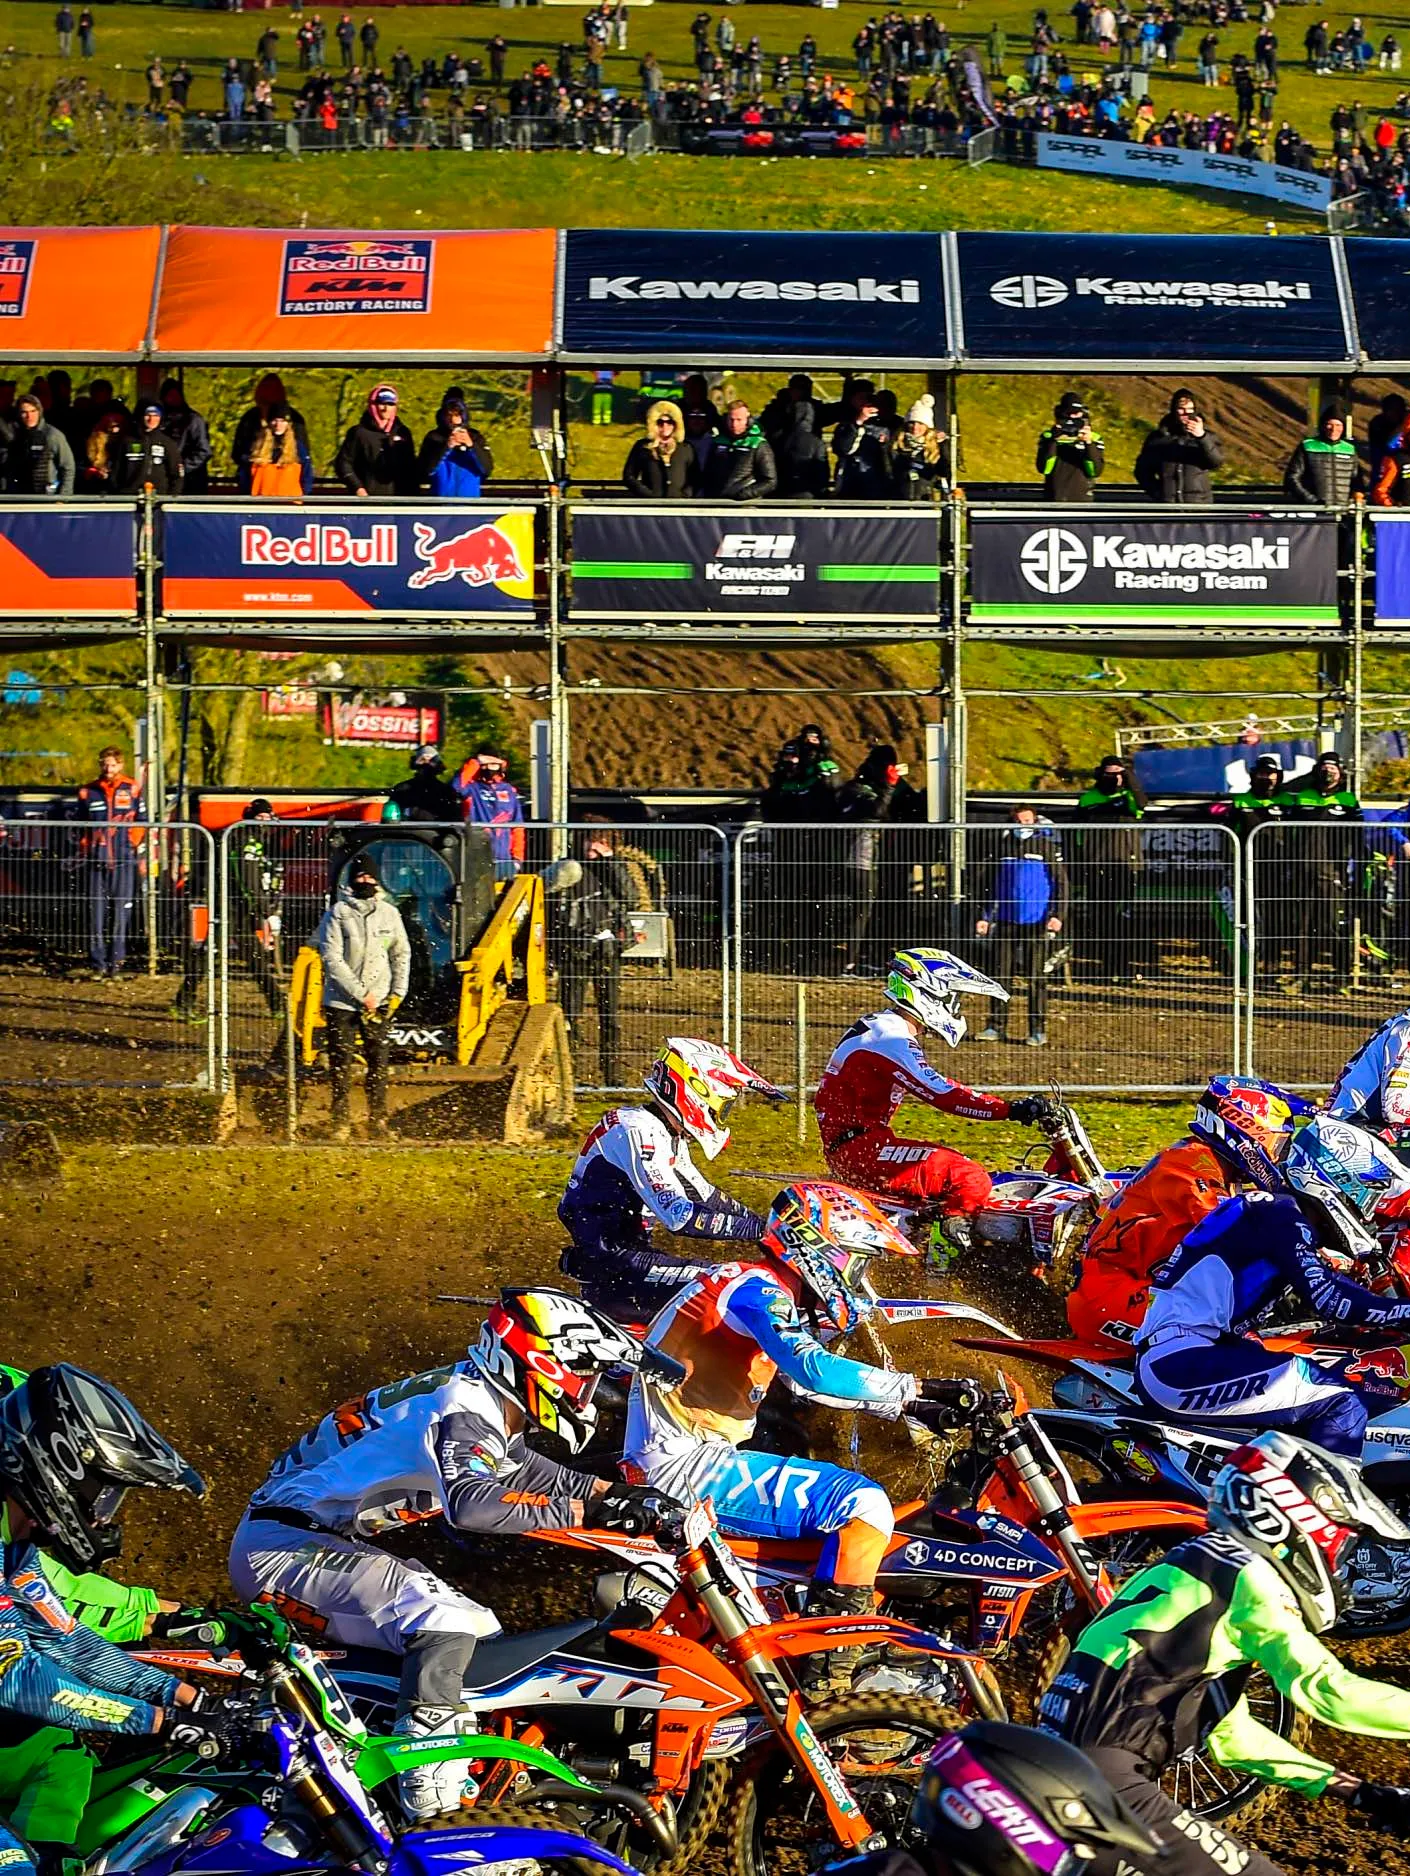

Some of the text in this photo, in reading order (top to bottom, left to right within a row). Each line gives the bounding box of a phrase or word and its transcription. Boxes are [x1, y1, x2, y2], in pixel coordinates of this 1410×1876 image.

[304, 277, 406, 293] KTM
[589, 276, 920, 303] Kawasaki
[1076, 278, 1311, 300] Kawasaki
[285, 300, 423, 313] FACTORY RACING
[1104, 294, 1286, 308] Racing Team
[242, 524, 398, 567] Red Bull
[1093, 534, 1290, 570] Kawasaki
[705, 563, 805, 581] Kawasaki
[1115, 570, 1267, 593] Racing Team
[877, 1147, 937, 1163] SHOT
[1178, 1373, 1271, 1411] THOR
[1258, 1459, 1342, 1552] 100%
[934, 1550, 1037, 1573] 4D CONCEPT
[824, 1623, 890, 1634] ACERBIS
[411, 1738, 460, 1750] MOTOREX
[808, 1744, 848, 1809] MOTOREX
